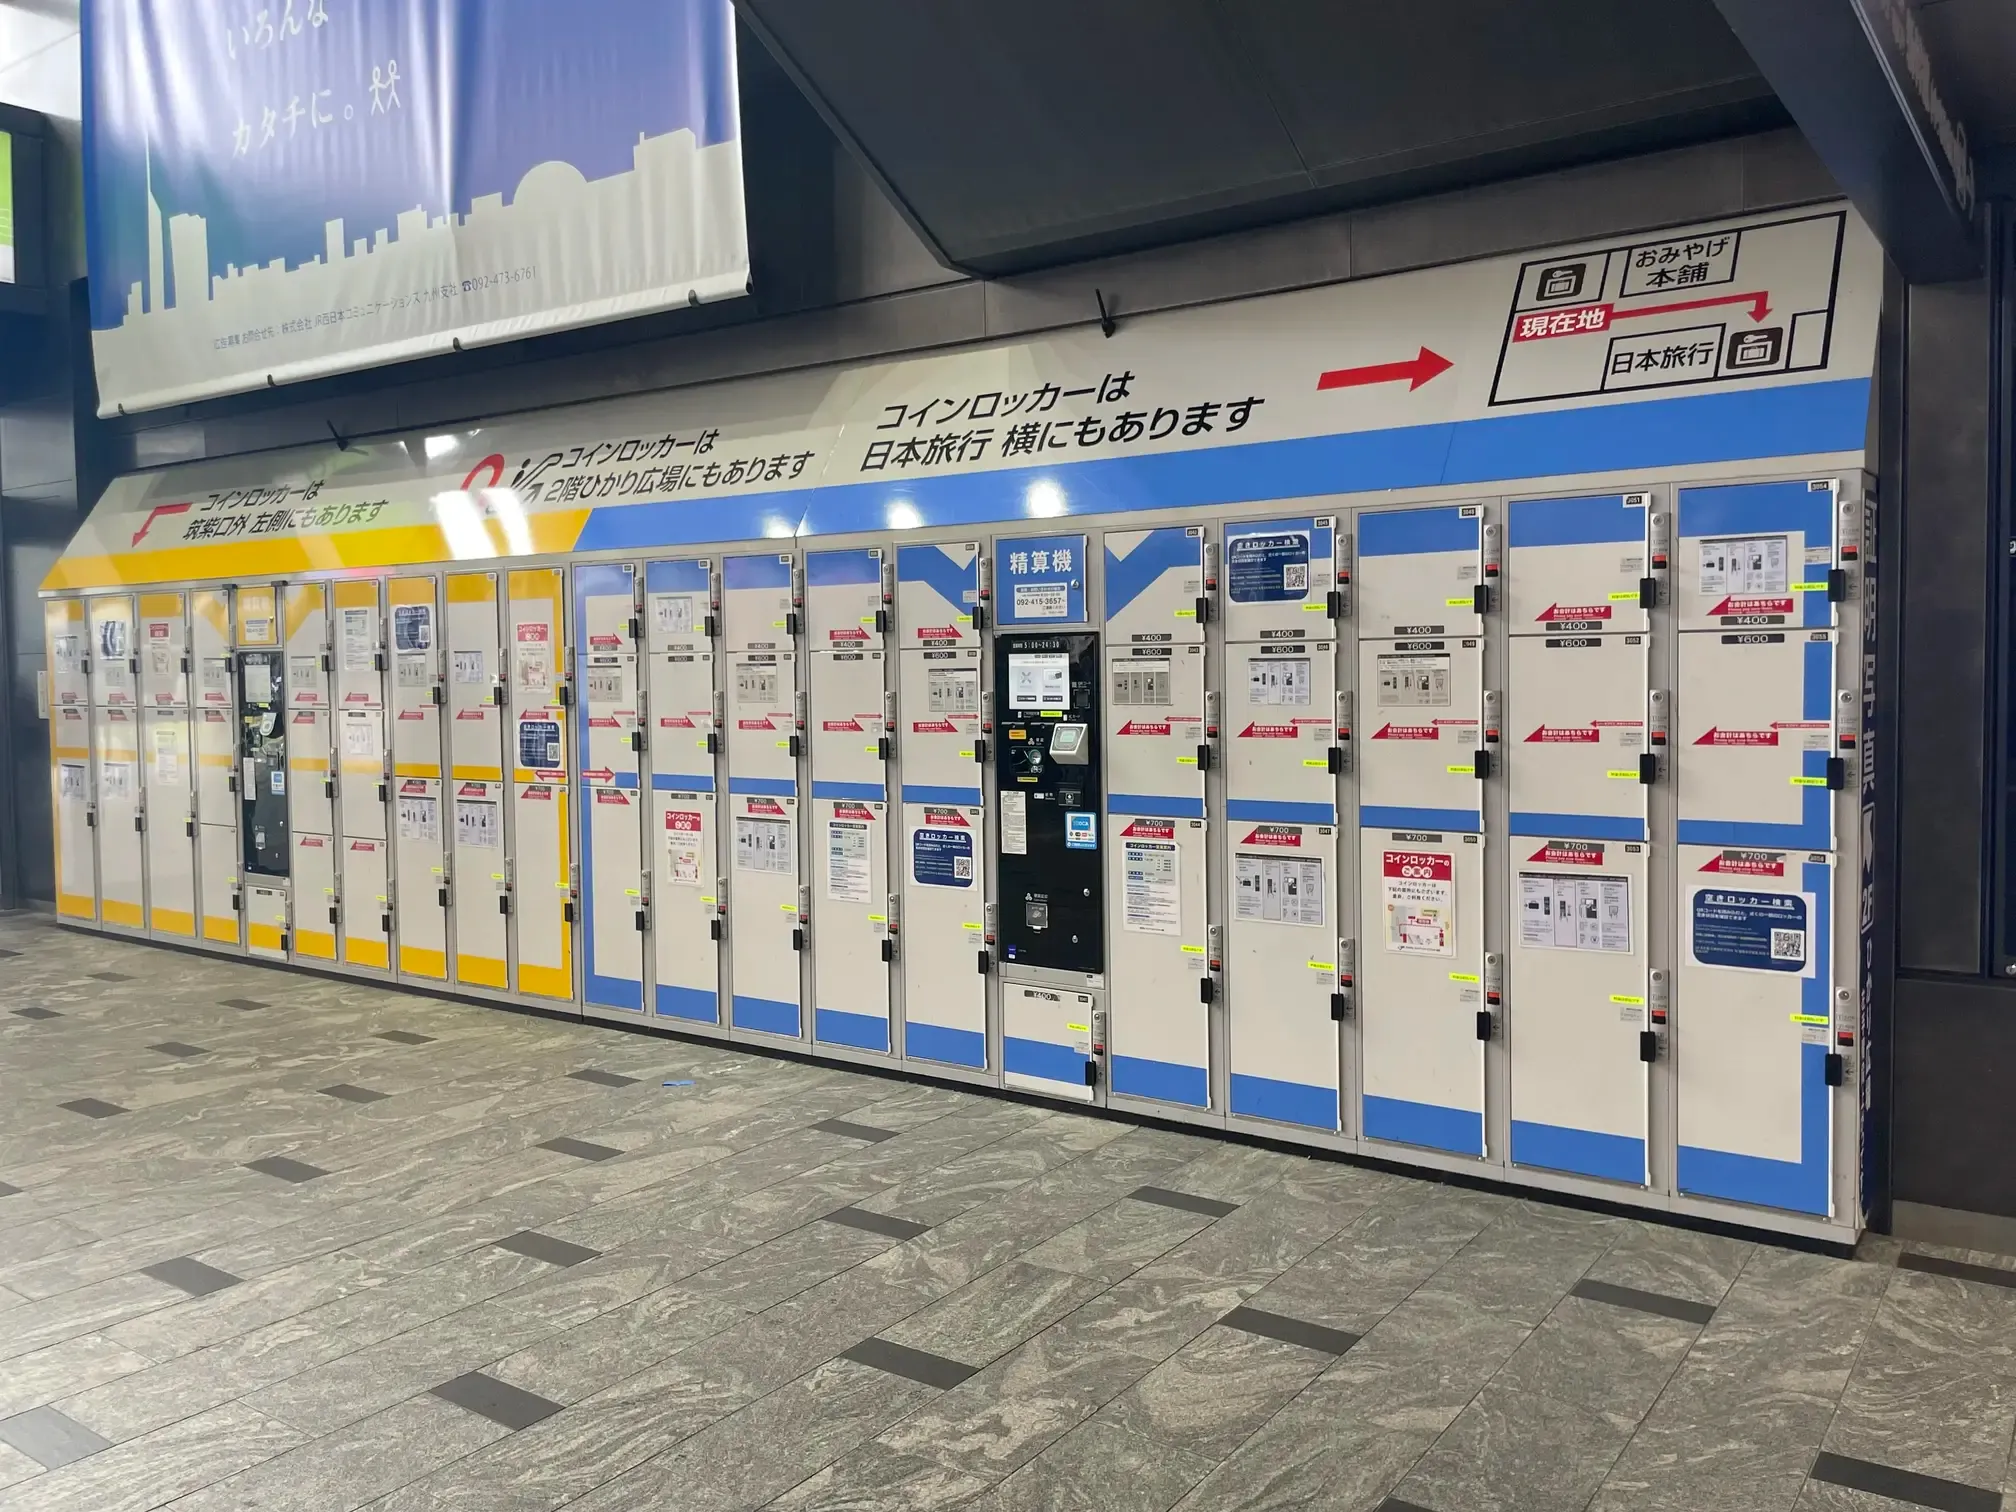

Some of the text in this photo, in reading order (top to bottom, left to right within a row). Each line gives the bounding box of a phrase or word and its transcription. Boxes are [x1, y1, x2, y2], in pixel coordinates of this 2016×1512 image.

[1635, 236, 1731, 268] おみやげ
[1645, 262, 1710, 288] 本舗
[281, 316, 312, 335] 株式会社
[471, 265, 537, 292] 092-473-6761
[1519, 307, 1606, 338] 現在地
[1610, 341, 1714, 376] 日本旅行
[877, 370, 1135, 431] コインロッカーは
[859, 396, 1266, 472] 日本旅行 横にもあります
[561, 428, 720, 469] コインロッカーは
[543, 450, 816, 503] 2階ひかり広場にもあります
[199, 479, 327, 512] コインロッカーは
[182, 499, 390, 541] 筑紫口外 左側にもあります
[1009, 549, 1072, 575] 精算機
[1406, 626, 1432, 634] ¥400
[1560, 622, 1588, 630] ¥400
[1737, 615, 1768, 624] ¥400
[1407, 642, 1432, 650] ¥600
[1560, 639, 1587, 647] ¥600
[1737, 635, 1769, 643] ¥600
[1405, 834, 1428, 842] ¥700
[1563, 842, 1588, 850] ¥700
[1385, 854, 1450, 867] コインロッカーの
[1741, 852, 1768, 861] ¥700
[1862, 883, 1873, 927] 2F
